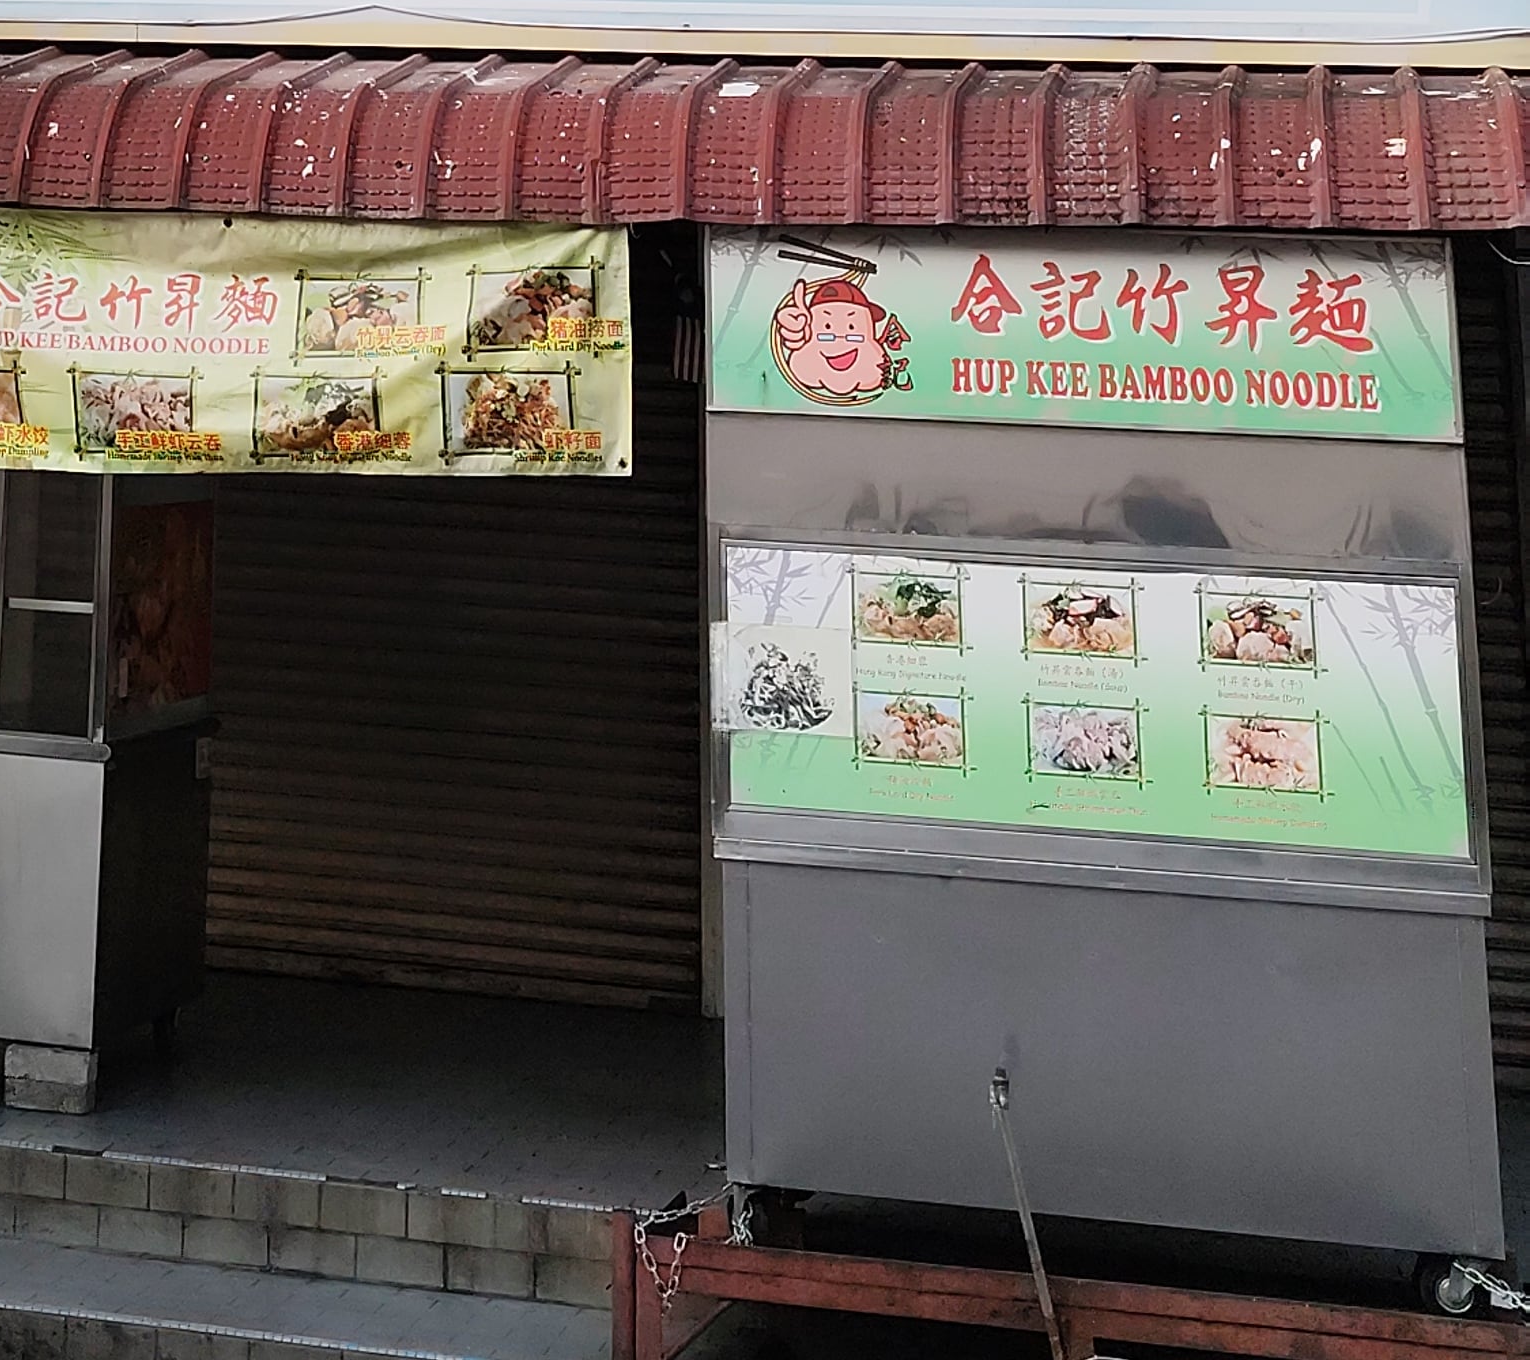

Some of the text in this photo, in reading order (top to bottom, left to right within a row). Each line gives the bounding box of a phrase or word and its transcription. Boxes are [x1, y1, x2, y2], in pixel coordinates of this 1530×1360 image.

[950, 252, 1378, 355] 合記竹昇麵
[20, 330, 63, 350] KEE
[68, 332, 168, 354] BAMBOO
[173, 335, 271, 356] NOODLE
[576, 340, 592, 353] Dry
[950, 357, 1383, 412] HUP KEE BAMBOO NOODLE
